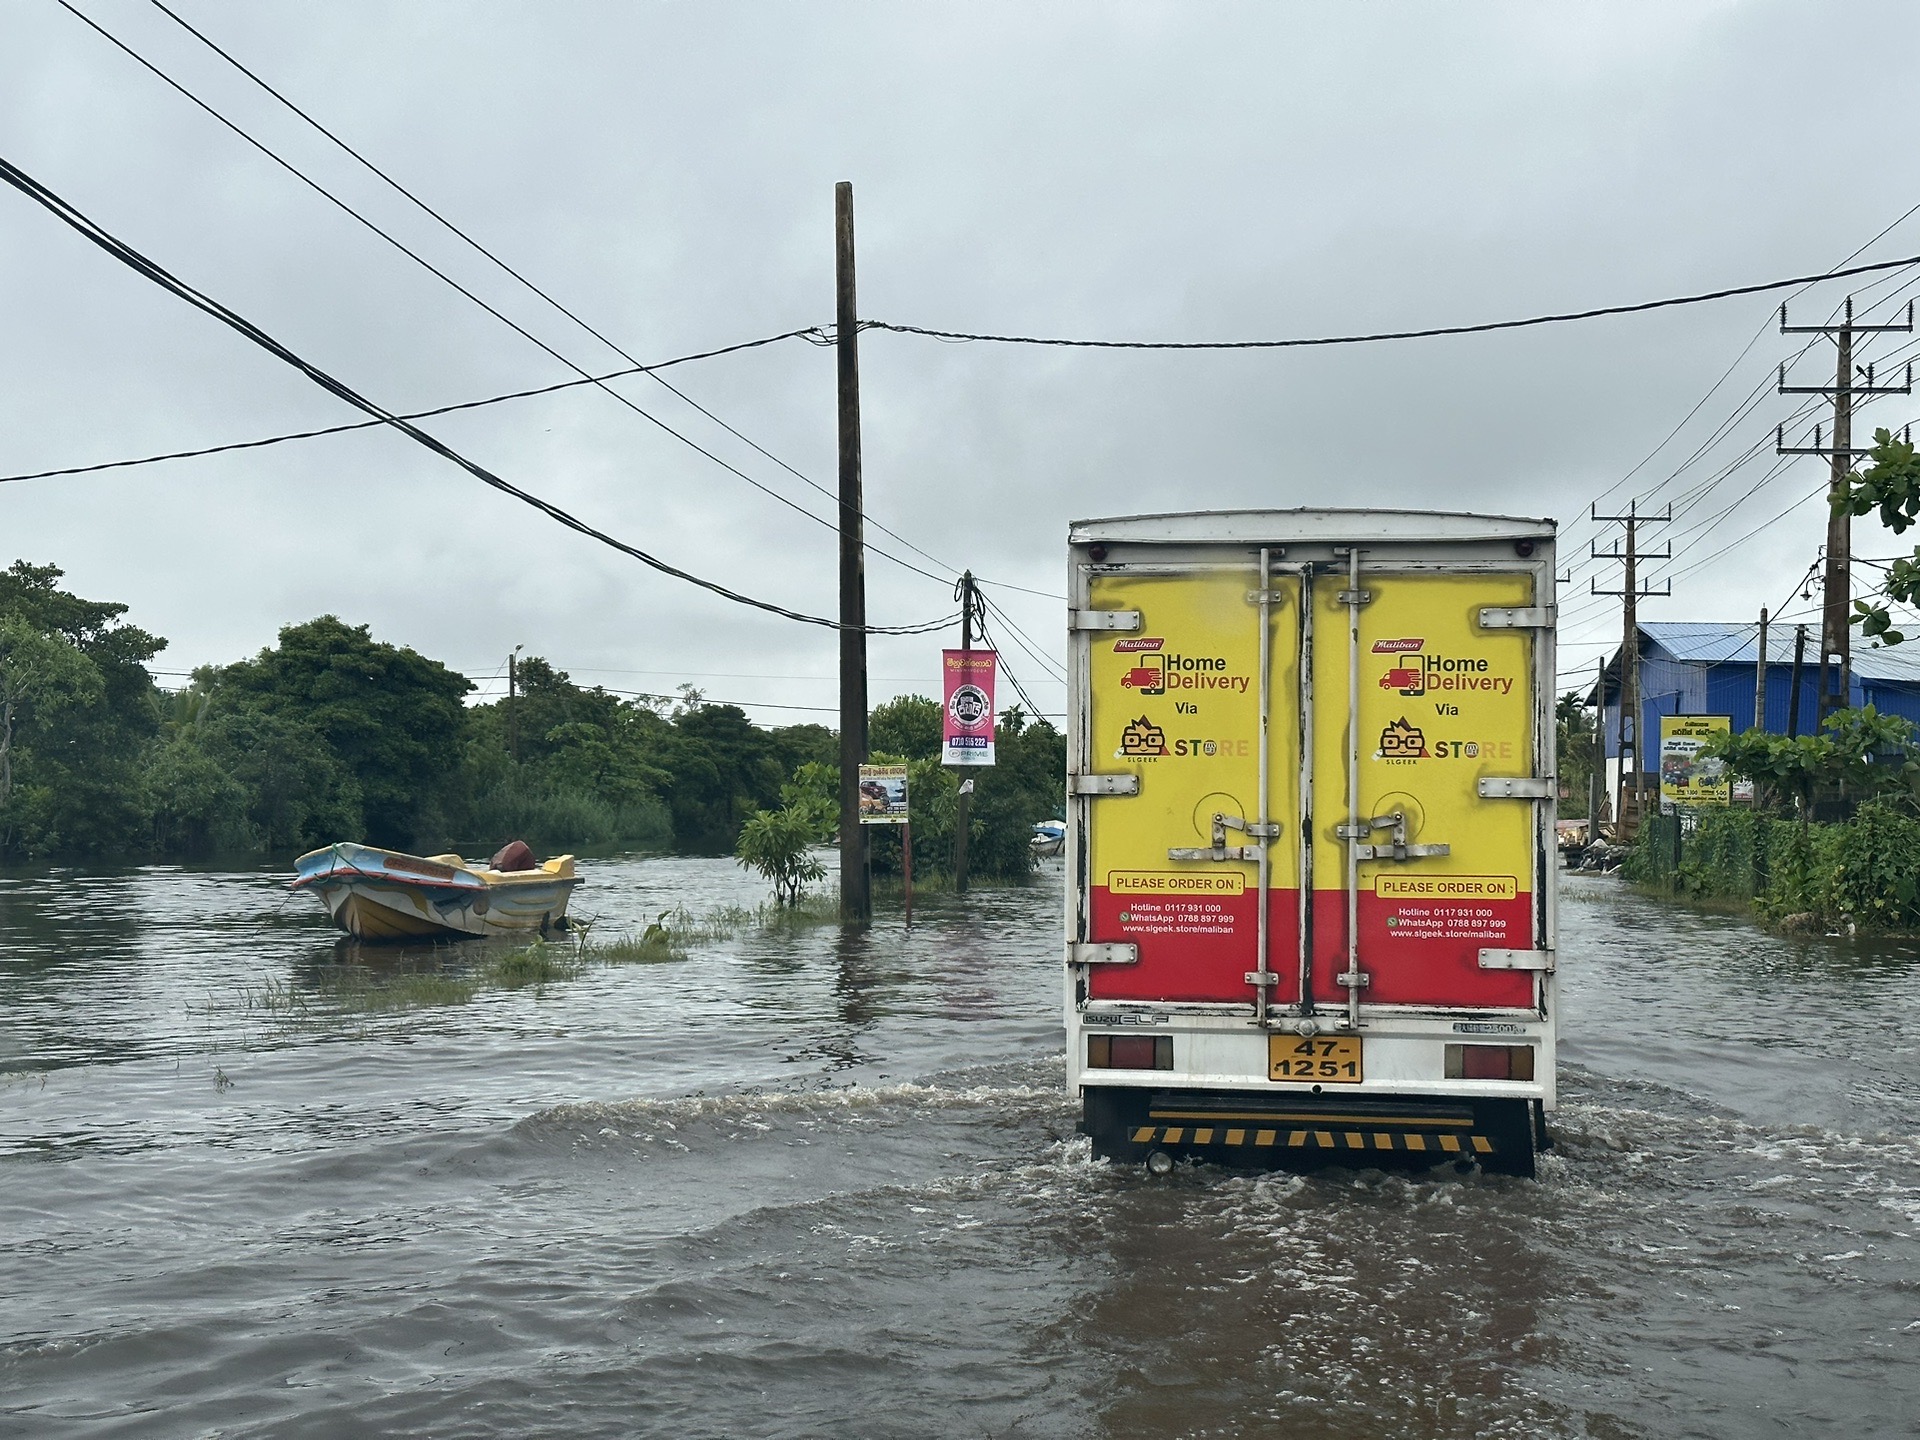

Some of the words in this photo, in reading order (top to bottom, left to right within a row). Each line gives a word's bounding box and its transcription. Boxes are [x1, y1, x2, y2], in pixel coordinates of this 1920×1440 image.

[1118, 640, 1160, 648] Maliban
[1376, 640, 1420, 649] Maliban
[1166, 654, 1226, 671] Home
[1426, 655, 1489, 672] Home
[1166, 672, 1251, 694] Delivery
[1426, 673, 1514, 695] Delivery
[1175, 702, 1198, 714] Via
[1435, 703, 1459, 716] Via
[975, 737, 986, 747] 222
[1174, 739, 1250, 757] STORE
[960, 750, 989, 758] PRIME
[1434, 741, 1513, 759] STORE
[1116, 878, 1165, 889] PLEASE
[1168, 879, 1213, 889] ORDER
[1216, 880, 1235, 890] ON
[1383, 882, 1434, 893] PLEASE
[1437, 882, 1484, 893] ORDER
[1487, 883, 1506, 893] ON
[1130, 903, 1161, 912] Hotline
[1164, 903, 1186, 912] 0117
[1187, 904, 1203, 912] 931
[1205, 904, 1221, 913] 000
[1398, 908, 1430, 917] Hotline
[1433, 908, 1456, 917] 0117
[1457, 909, 1474, 917] 931
[1475, 909, 1493, 918] 000
[1130, 913, 1175, 924] WhatsApp
[1177, 914, 1199, 923] 0788
[1200, 914, 1217, 923] 897
[1217, 915, 1235, 923] 999
[1398, 918, 1444, 929] WhatsApp
[1447, 919, 1469, 928] 0788
[1471, 919, 1488, 928] 897
[1489, 920, 1507, 928] 999
[1122, 924, 1234, 934] www.slgeek.store/maliban
[1390, 930, 1506, 940] www.slgeek.store/maliban
[1085, 1014, 1118, 1023] ISUZU
[1120, 1014, 1169, 1026] ELF
[1293, 1040, 1350, 1057] 47-
[1276, 1059, 1356, 1077] 1251
